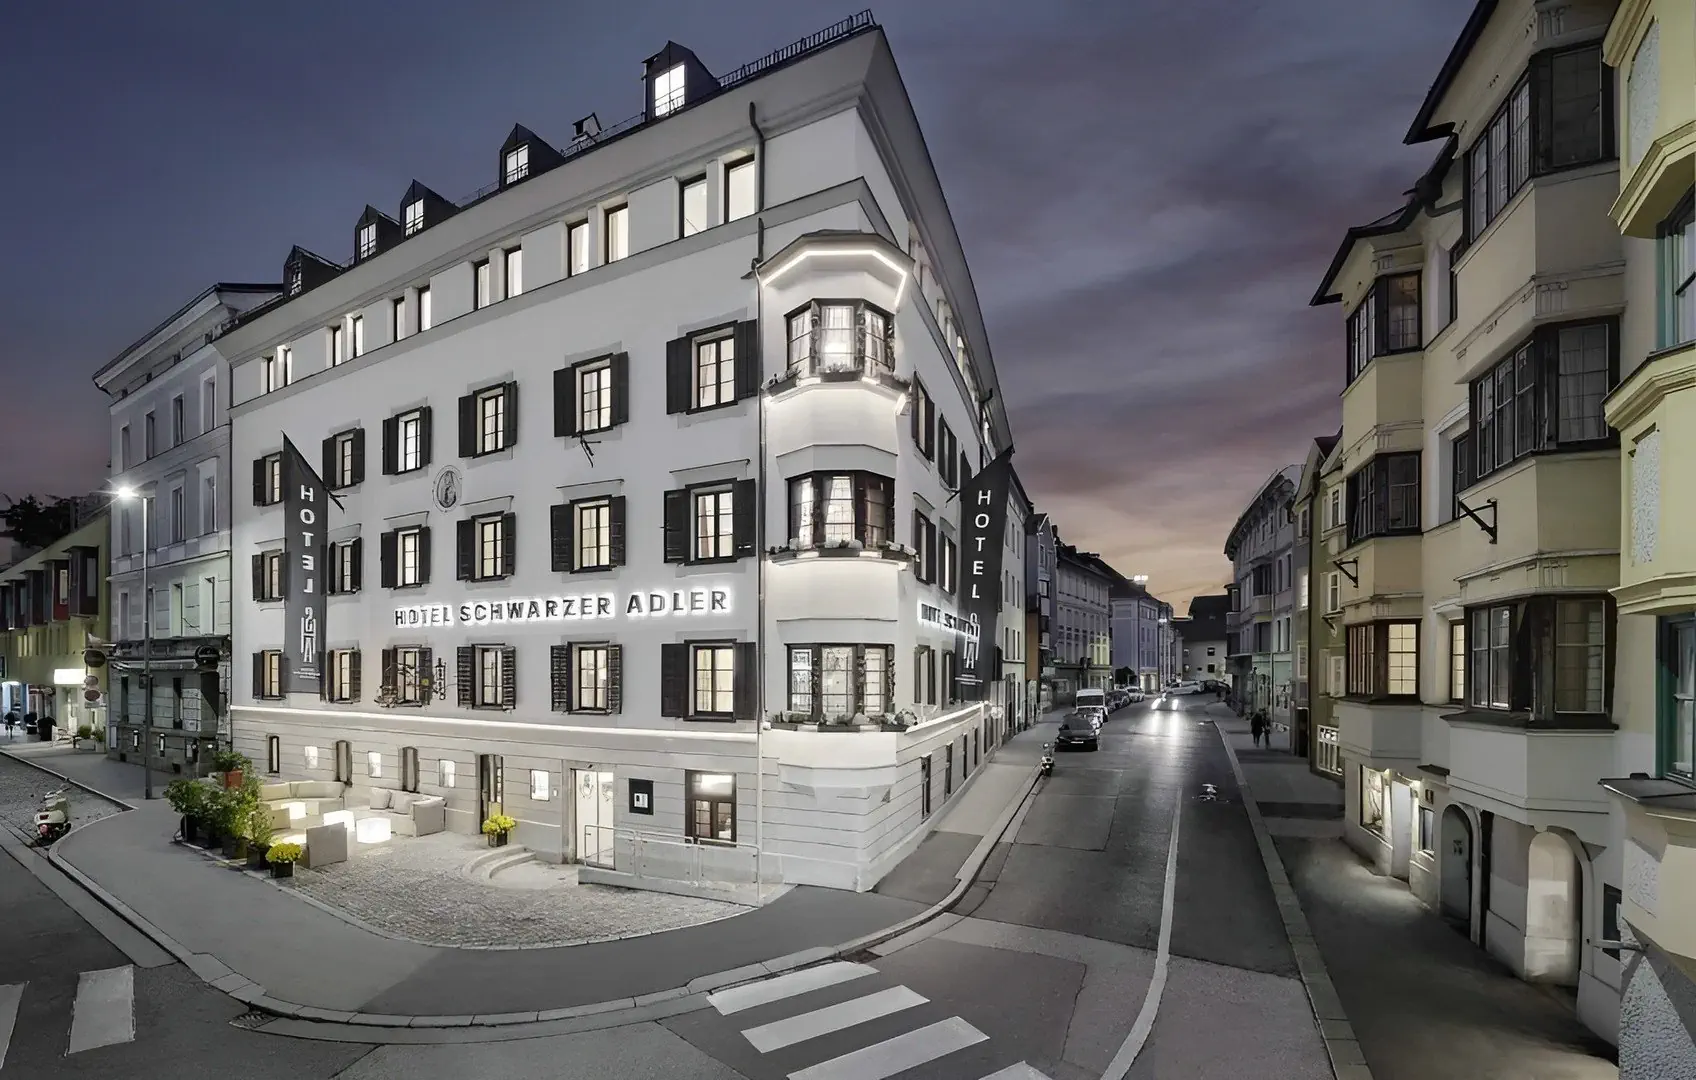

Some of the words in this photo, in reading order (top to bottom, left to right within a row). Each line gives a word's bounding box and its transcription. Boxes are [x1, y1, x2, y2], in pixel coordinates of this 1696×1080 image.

[971, 489, 992, 599] HOTEL
[394, 606, 452, 626] HOTEL
[459, 596, 611, 622] SCHWARZER
[626, 590, 727, 614] ADLER
